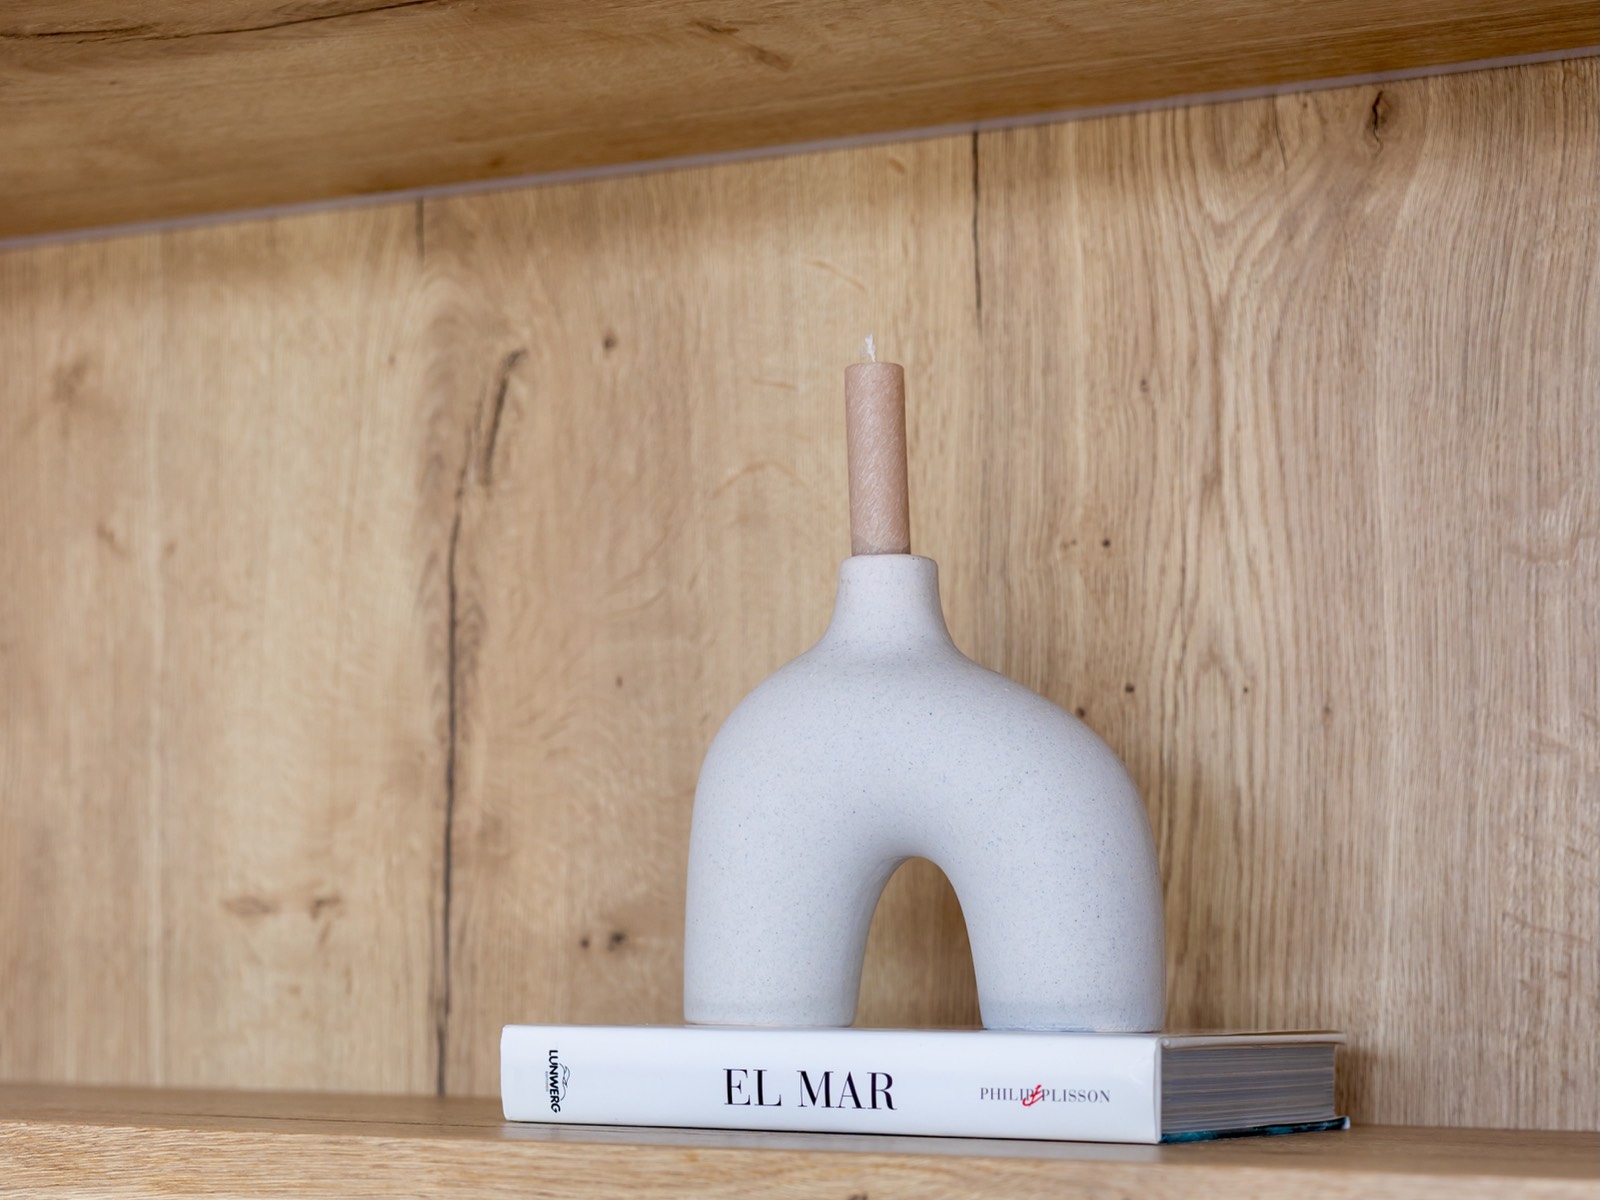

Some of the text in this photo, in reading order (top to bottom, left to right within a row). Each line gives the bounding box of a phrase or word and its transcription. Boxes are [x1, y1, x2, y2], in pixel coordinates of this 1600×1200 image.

[548, 1049, 561, 1113] LUNWERG
[723, 1068, 898, 1110] EL MAR
[980, 1087, 1111, 1103] PHILIP PLISSON
